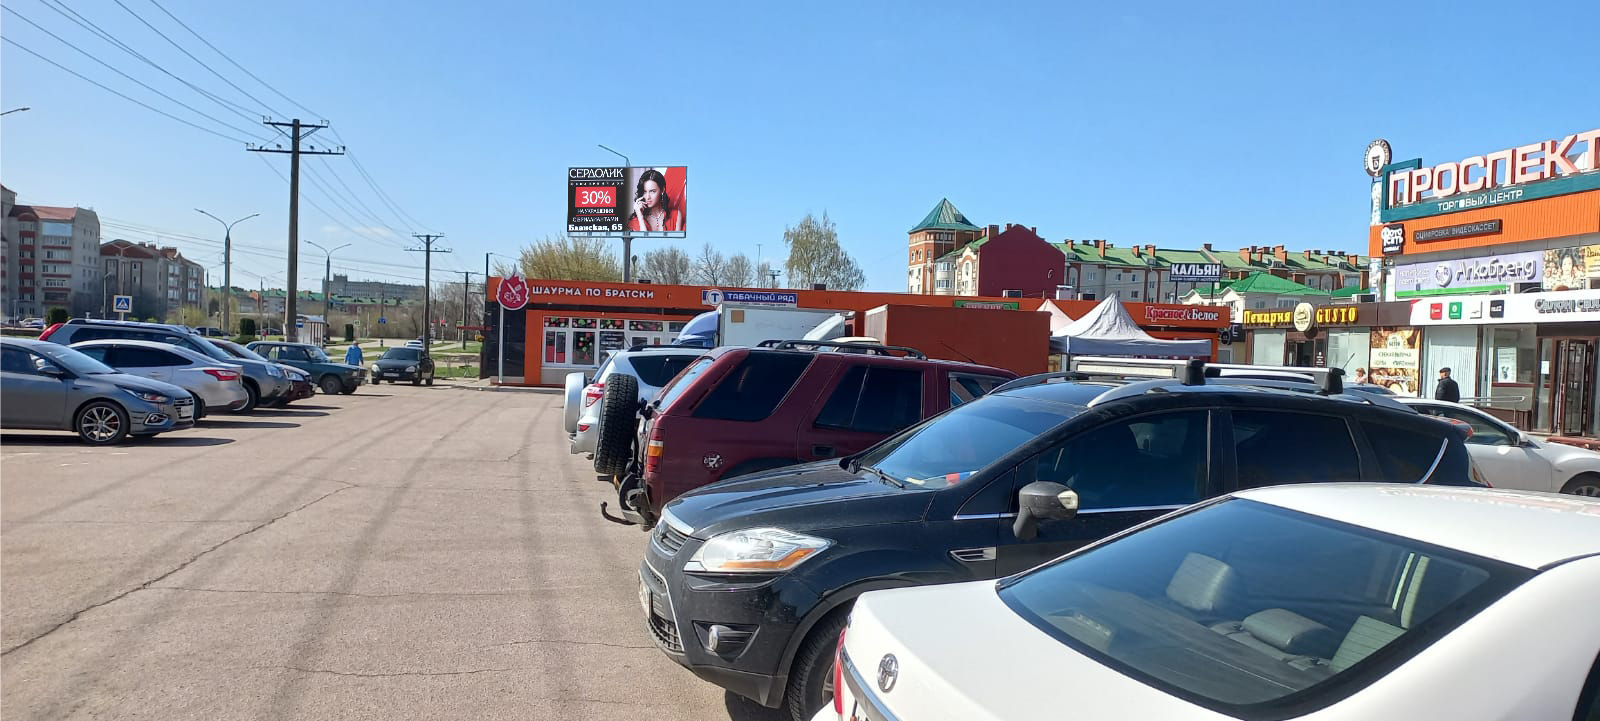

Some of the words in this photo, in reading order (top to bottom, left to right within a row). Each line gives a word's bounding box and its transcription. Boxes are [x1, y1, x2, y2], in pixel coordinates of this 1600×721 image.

[569, 168, 624, 179] СЕРДОЛИК
[1388, 128, 1600, 206] ПРОСПЕКТ
[581, 190, 611, 205] 30%
[1438, 195, 1488, 212] ТОРГОВЫЙ
[1489, 189, 1523, 204] ЦЕНТР
[611, 223, 623, 231] 65
[1171, 263, 1220, 276] КАЛЬЯН
[532, 286, 582, 296] ШАУРМА
[585, 288, 601, 297] ПО
[605, 289, 654, 299] БРАТСКИ
[728, 293, 775, 301] ТАБАЧНЫЙ
[1243, 310, 1291, 327] Пекарня
[1316, 307, 1357, 323] GUSTO
